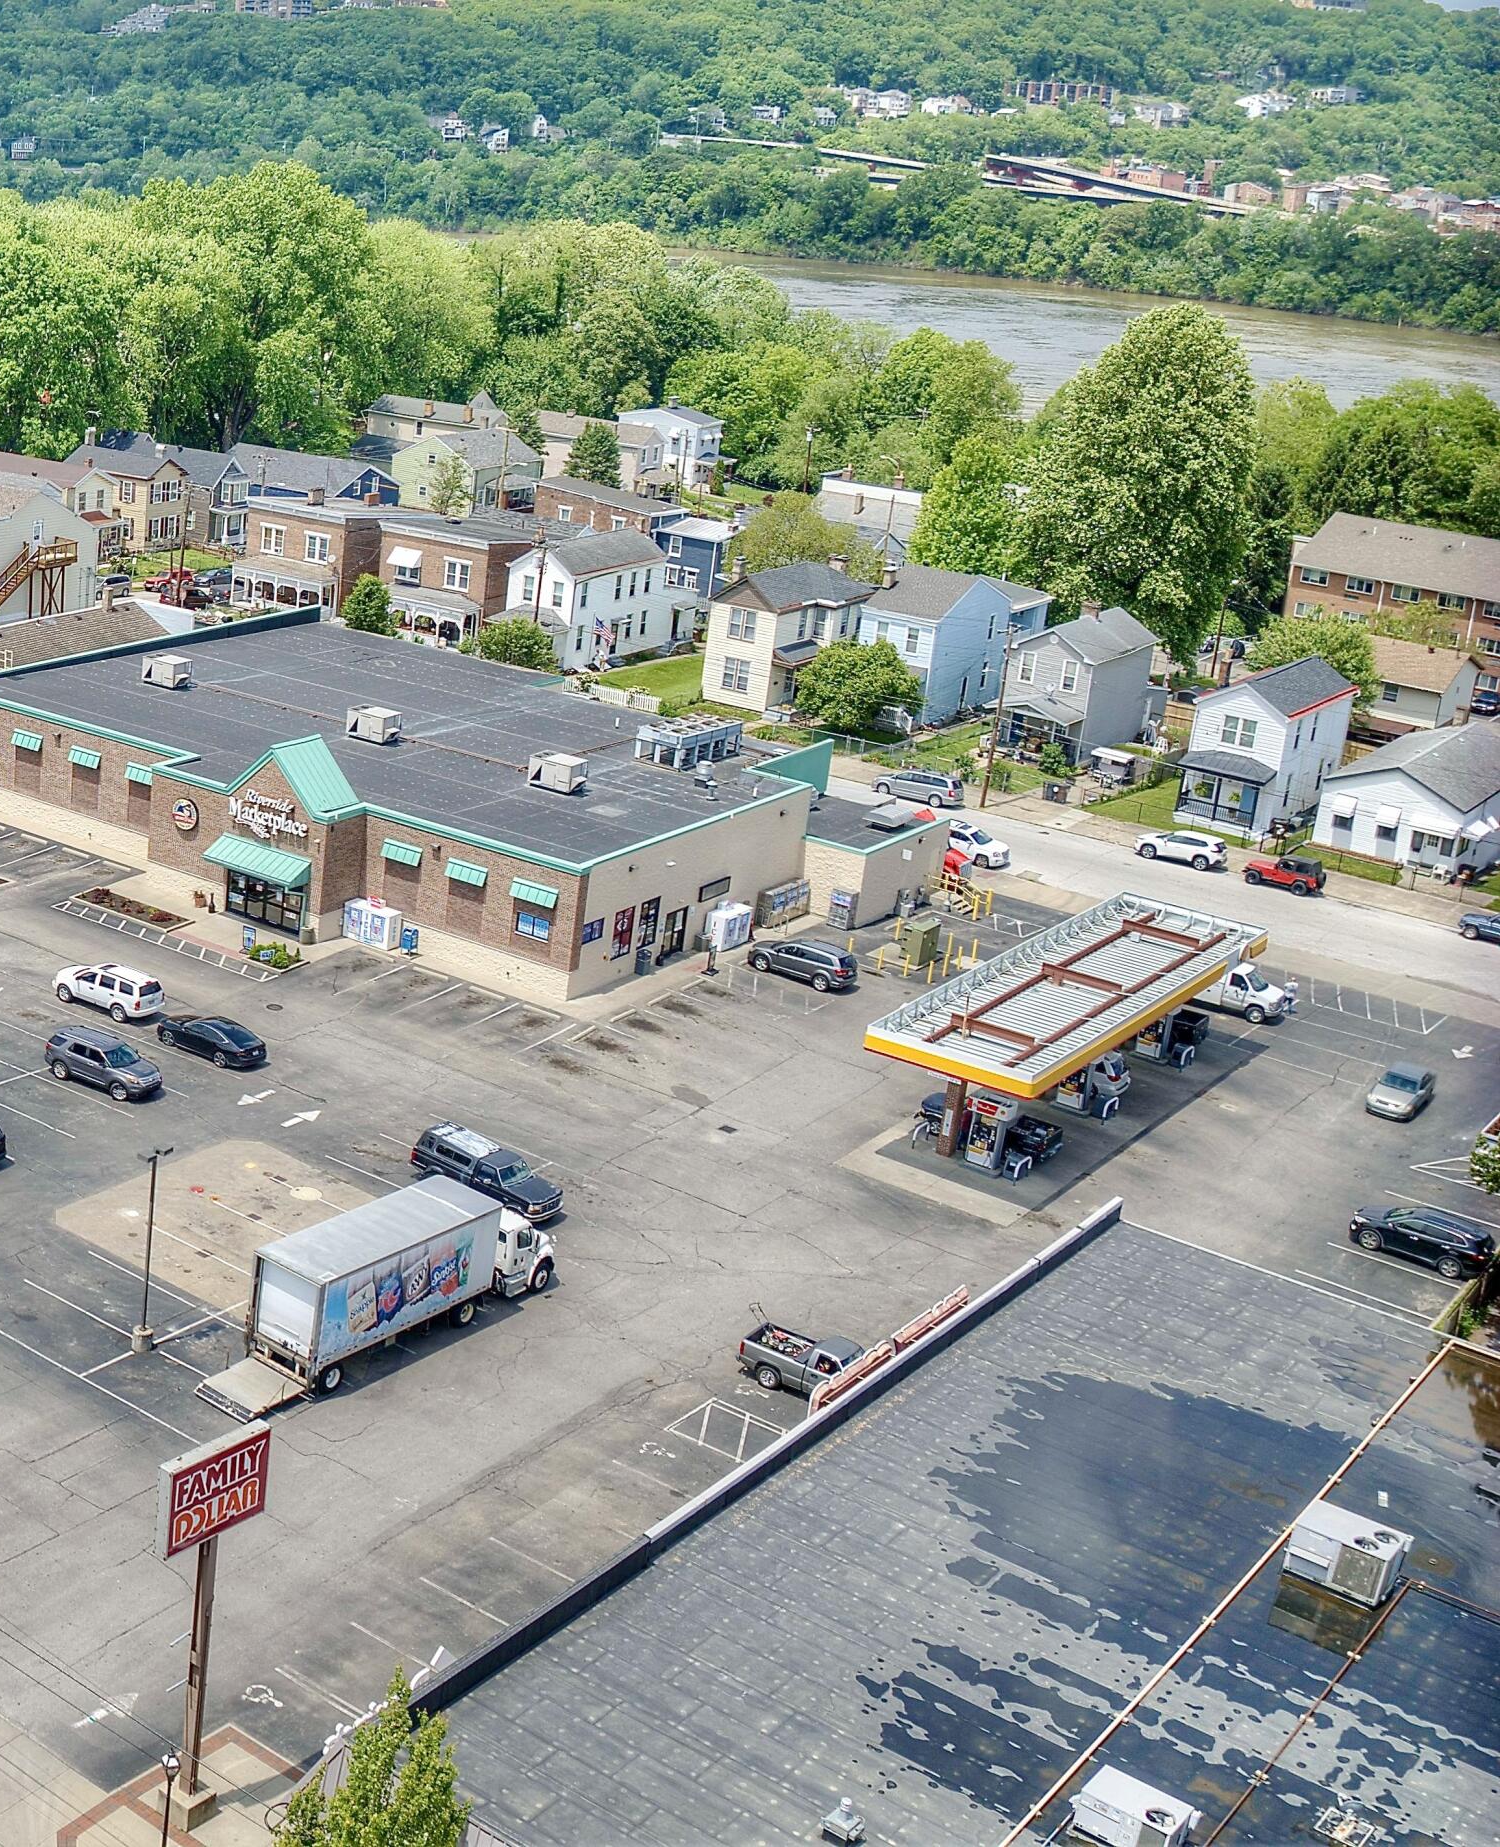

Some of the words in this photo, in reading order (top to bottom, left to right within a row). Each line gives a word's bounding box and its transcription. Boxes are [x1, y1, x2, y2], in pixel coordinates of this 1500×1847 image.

[228, 796, 308, 838] Marketplace
[245, 788, 295, 813] Riverside
[175, 1439, 266, 1512] FAMILY
[173, 1477, 259, 1547] DOLLAR
